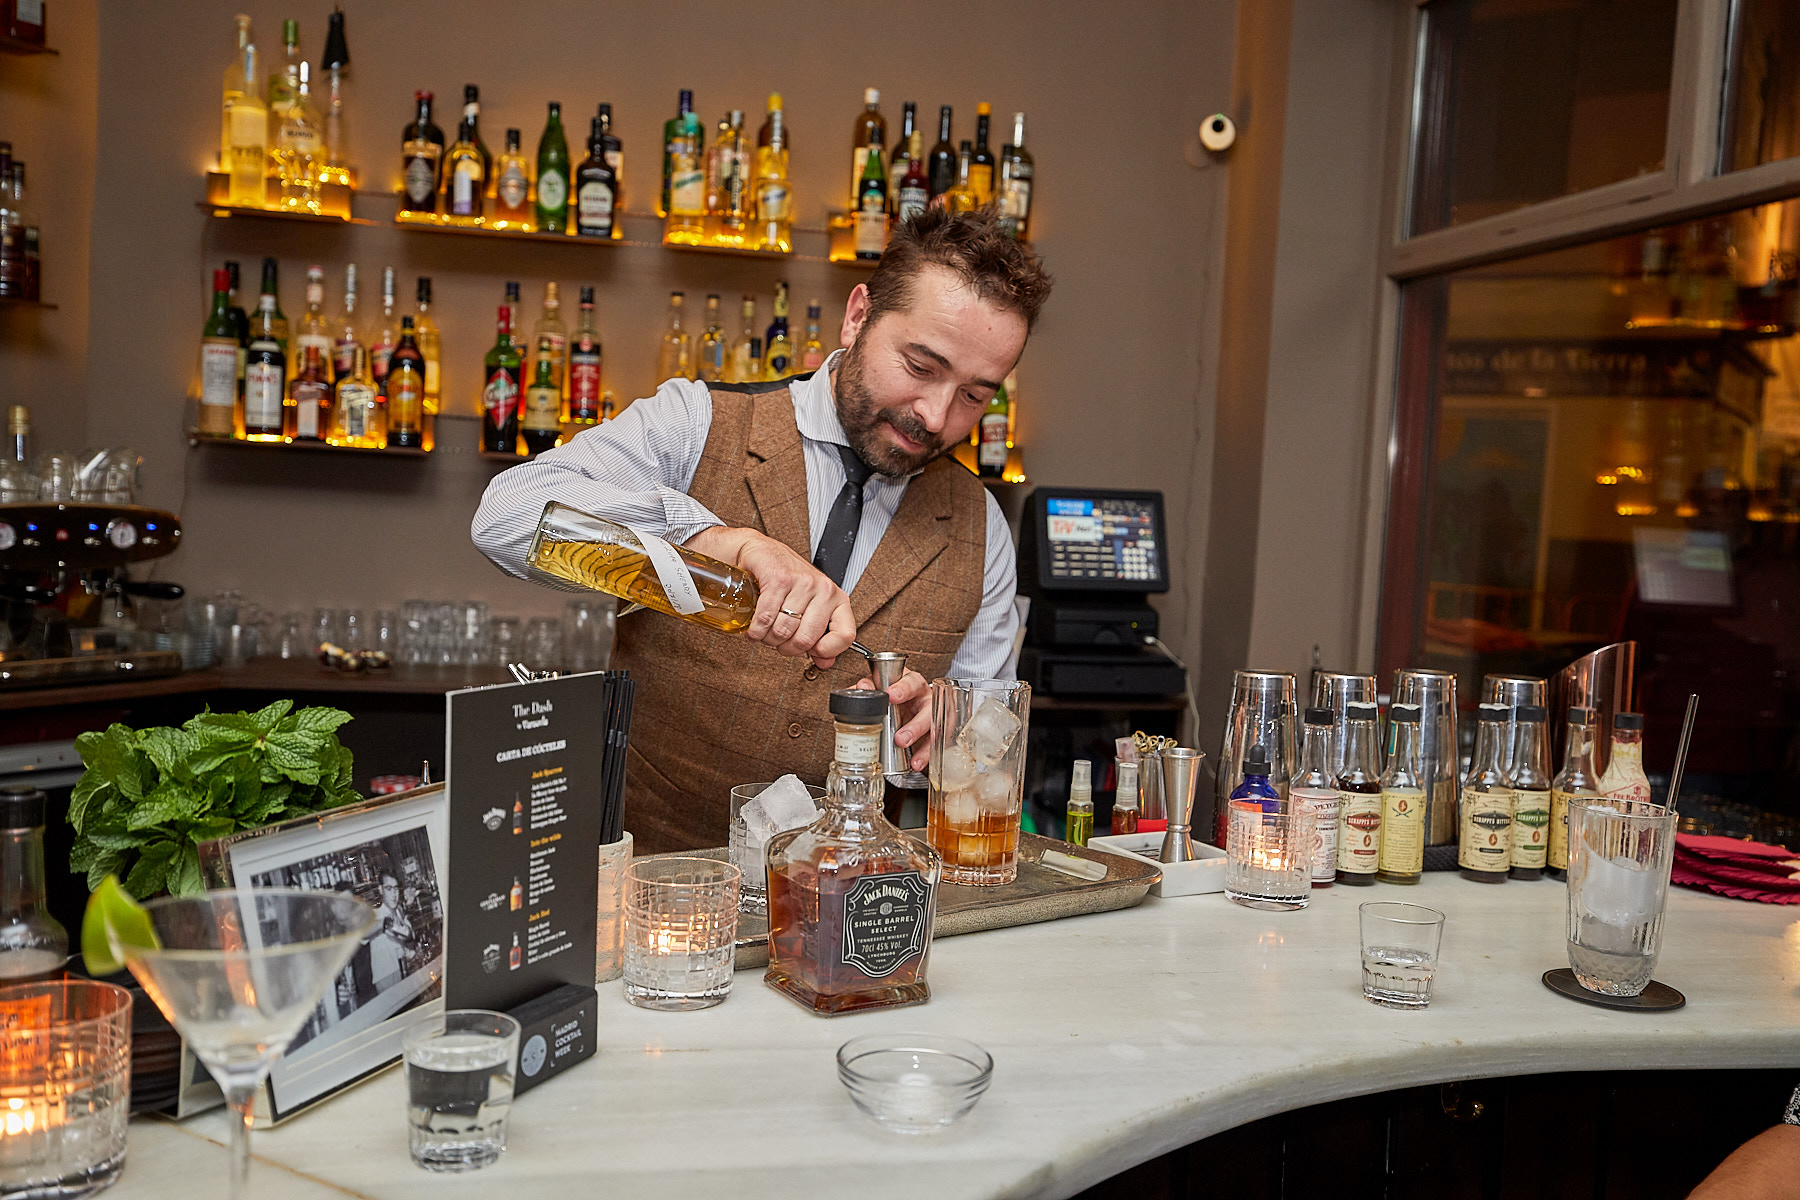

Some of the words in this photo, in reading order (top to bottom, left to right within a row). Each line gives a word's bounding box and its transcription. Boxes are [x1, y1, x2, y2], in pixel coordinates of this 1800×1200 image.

[512, 703, 530, 718] The
[531, 699, 553, 715] Dash
[496, 748, 521, 762] CARTA
[521, 746, 532, 758] DE
[863, 888, 881, 906] JACK
[882, 884, 909, 902] DANIEL'S
[854, 918, 882, 928] SINGLE
[885, 915, 915, 925] BARREL
[871, 925, 897, 934] SELECT
[876, 941, 889, 951] 45%
[555, 1020, 579, 1037] MADRID
[554, 1028, 582, 1048] COCKTAIL
[554, 1044, 572, 1059] WEEK
